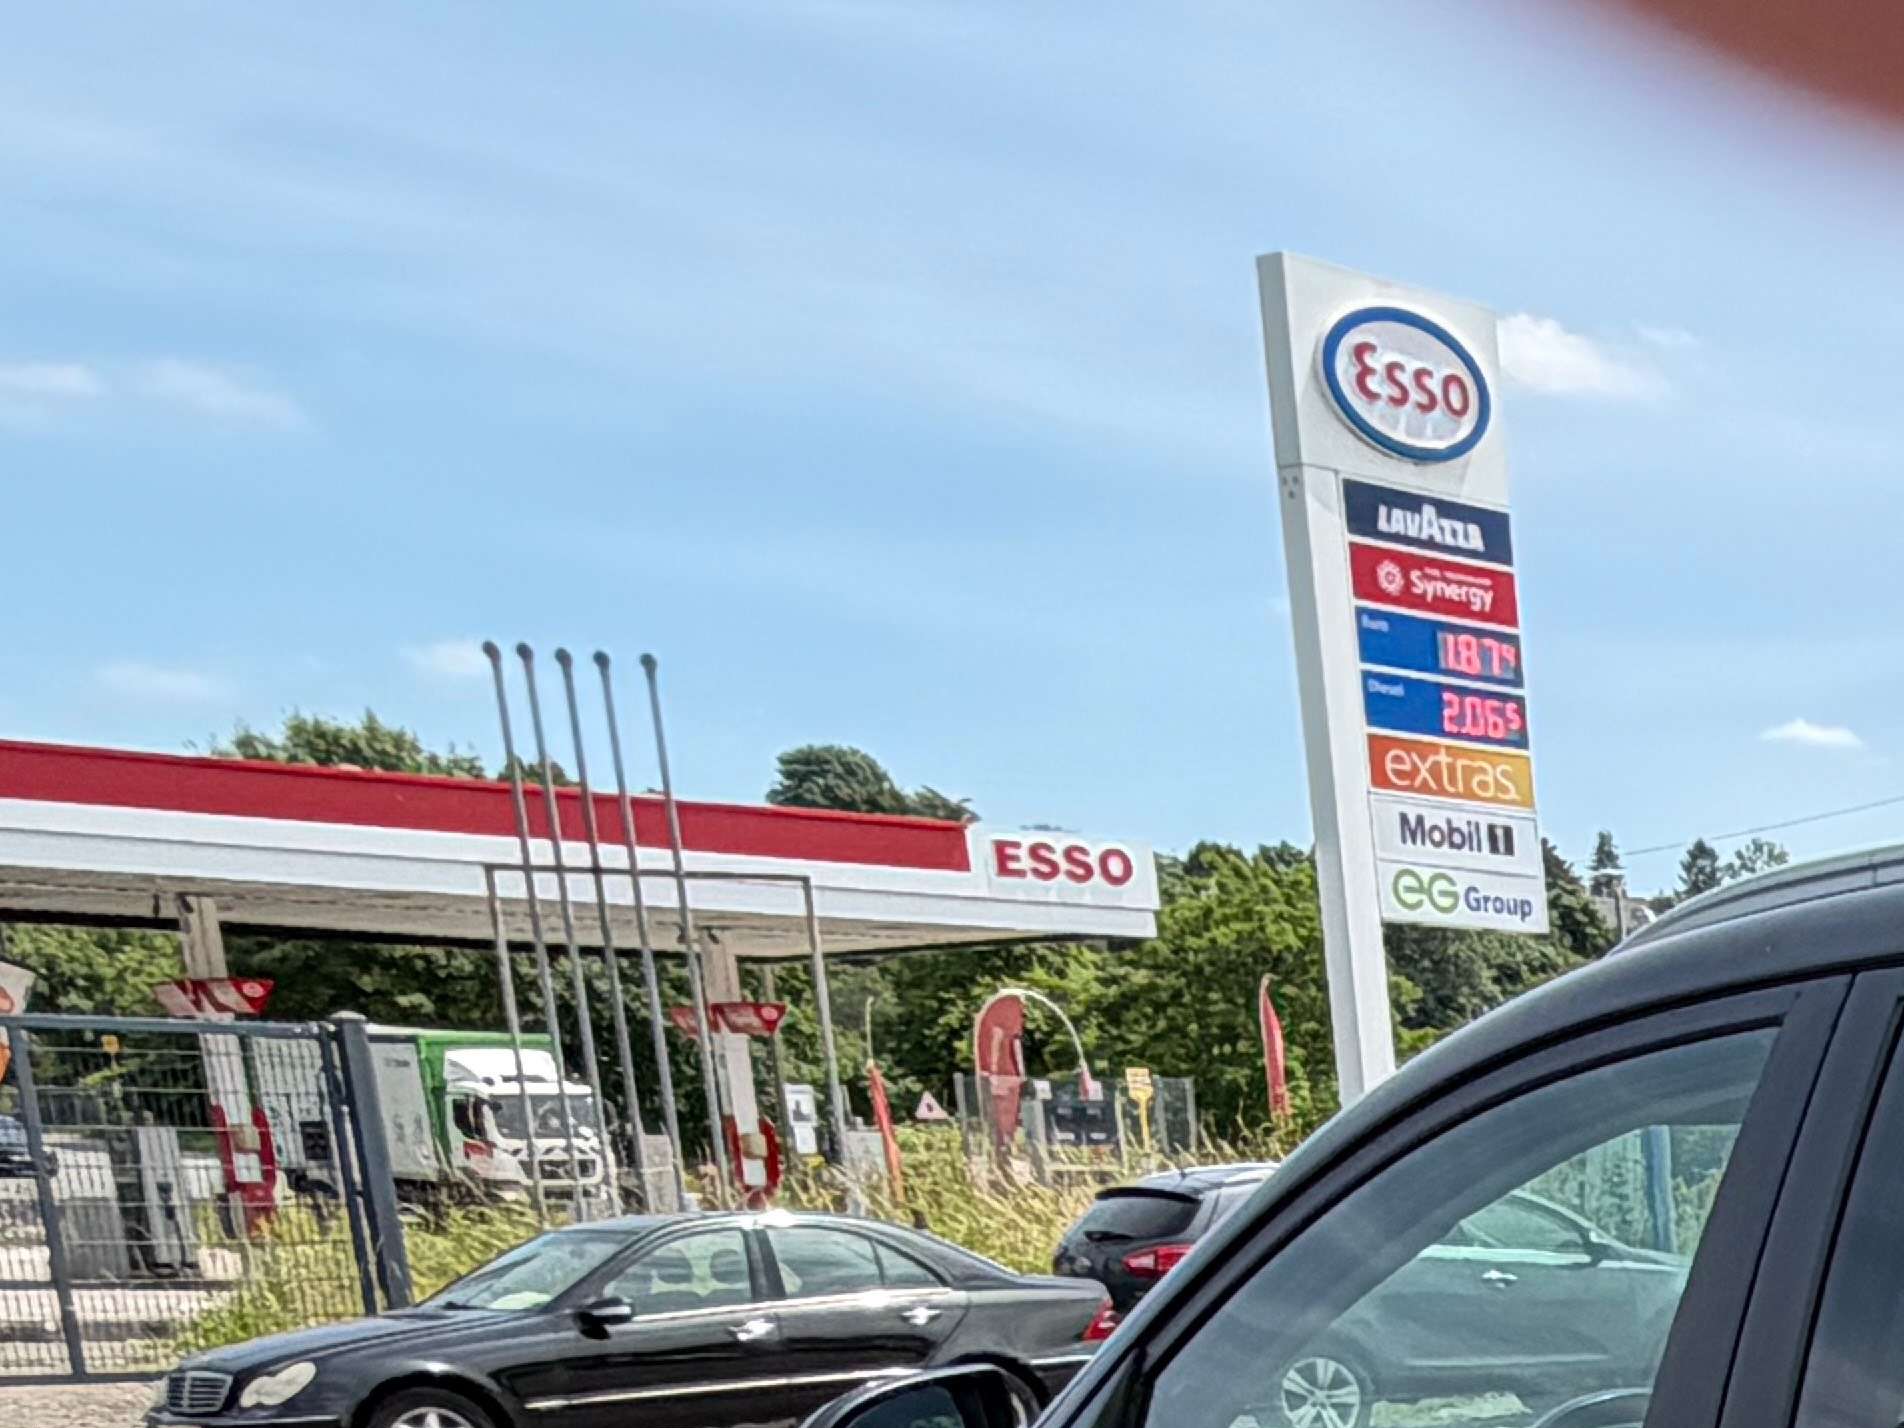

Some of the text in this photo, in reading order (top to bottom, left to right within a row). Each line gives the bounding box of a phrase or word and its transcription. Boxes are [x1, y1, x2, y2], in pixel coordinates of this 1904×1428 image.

[1409, 569, 1494, 613] Synergy
[1384, 746, 1521, 800] extras
[1399, 812, 1482, 853] Mobil
[992, 839, 1134, 887] ESSO
[1464, 886, 1533, 922] Group
